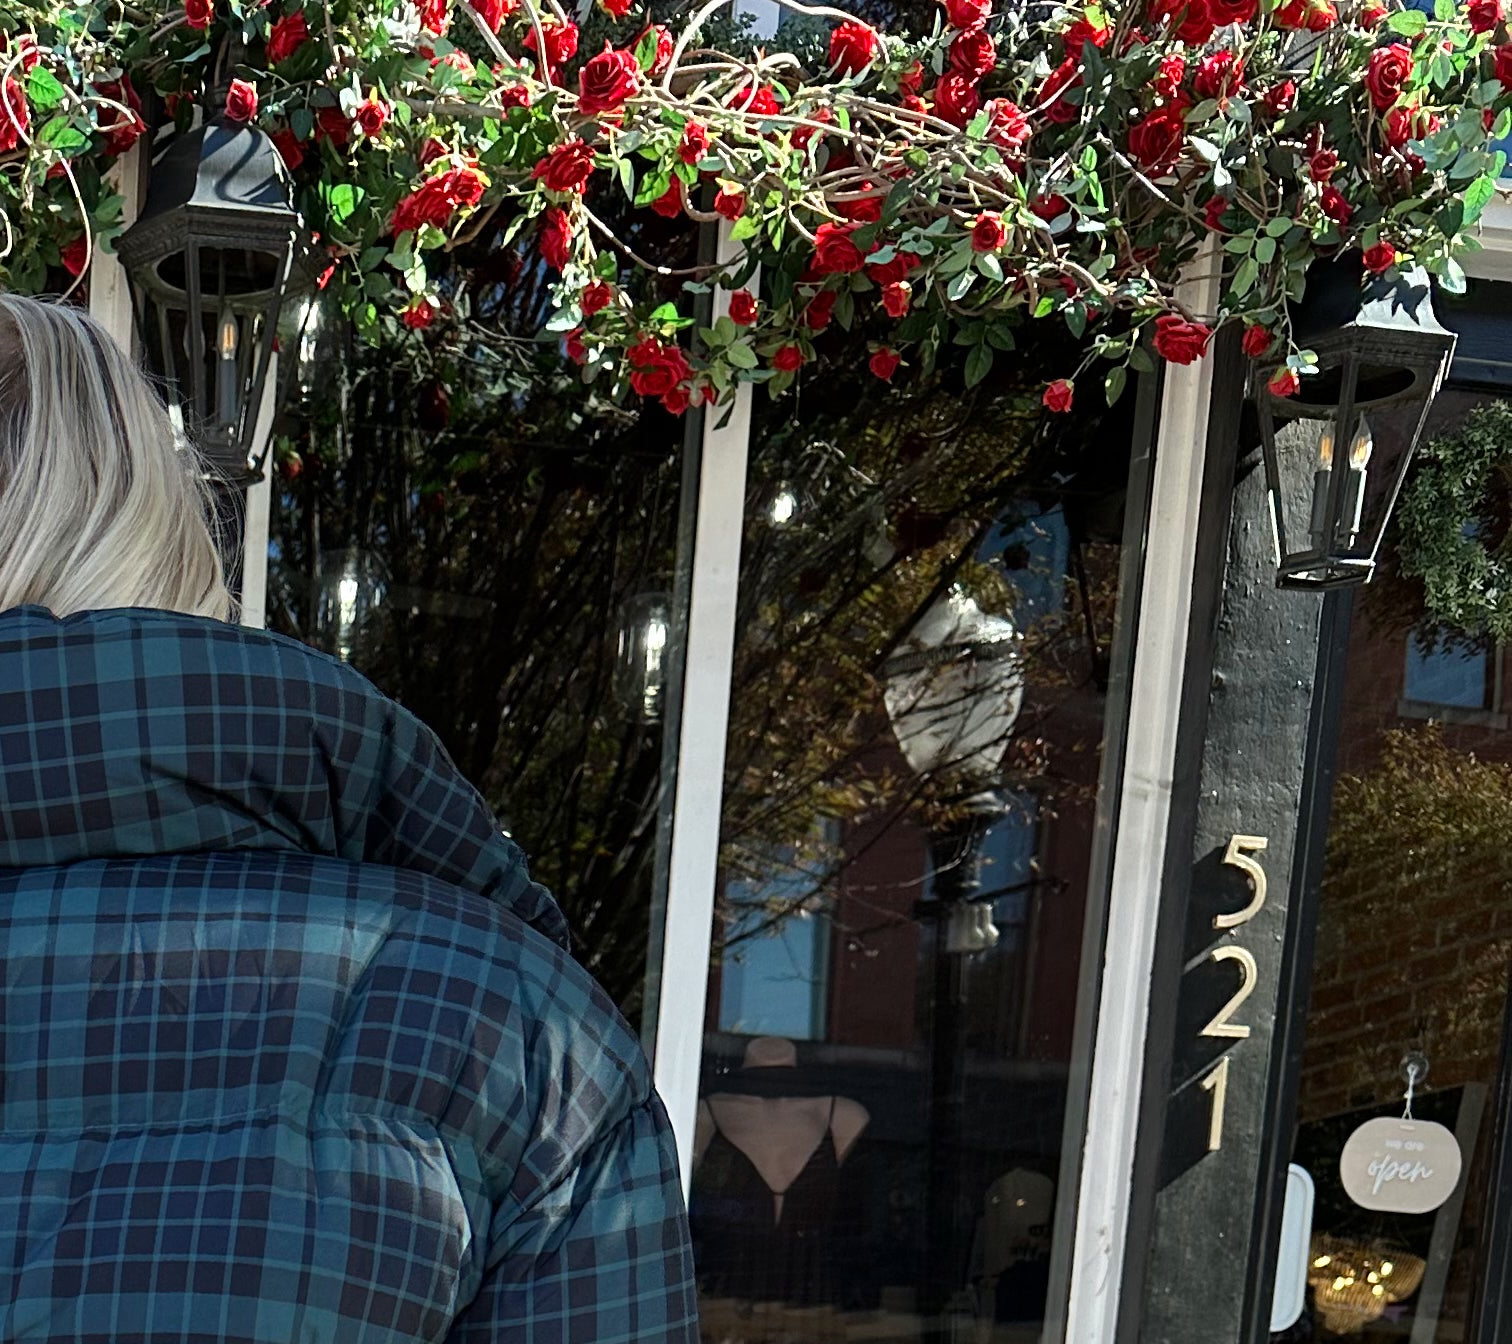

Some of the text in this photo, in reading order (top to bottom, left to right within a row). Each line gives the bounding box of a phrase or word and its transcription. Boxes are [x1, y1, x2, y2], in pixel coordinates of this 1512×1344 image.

[1198, 833, 1269, 1151] 521
[1385, 1139, 1426, 1152] we are
[1367, 1154, 1434, 1195] open
